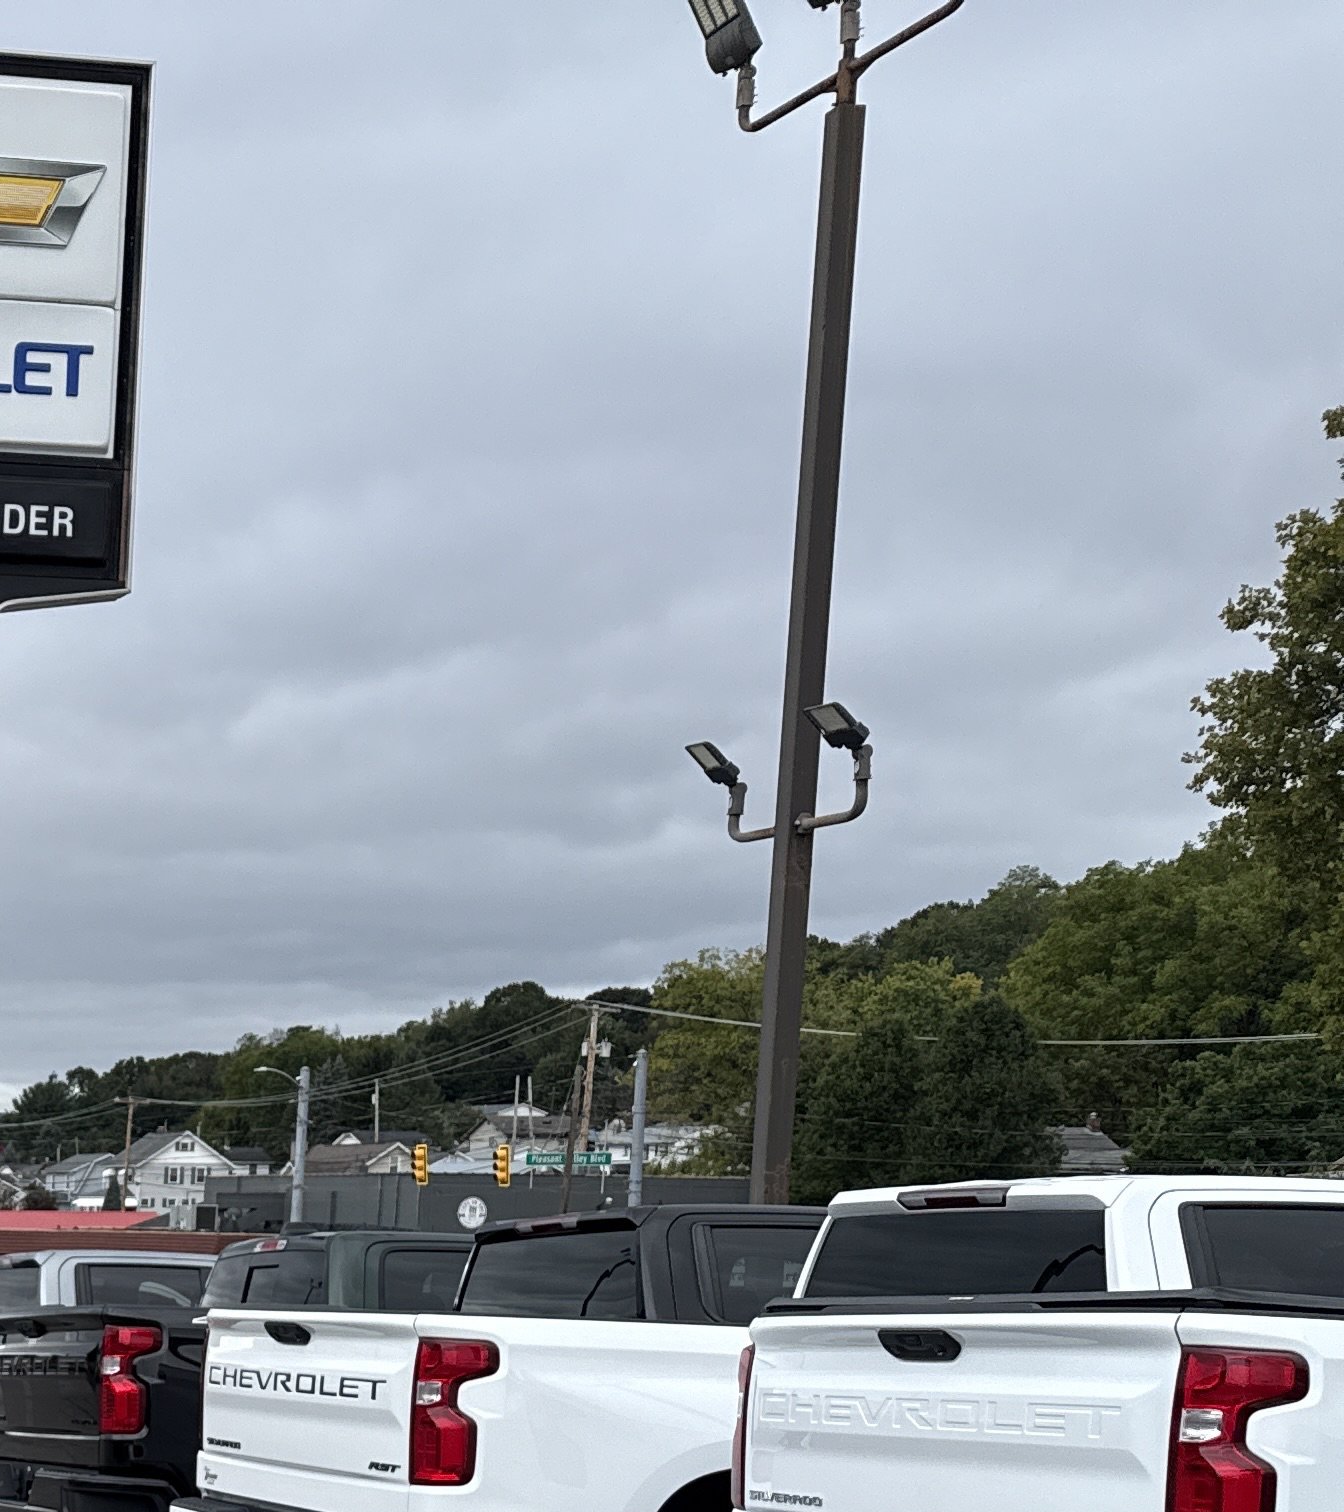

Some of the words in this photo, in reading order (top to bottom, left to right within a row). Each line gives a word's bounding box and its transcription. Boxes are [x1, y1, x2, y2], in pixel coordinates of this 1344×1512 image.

[531, 1154, 563, 1164] Pleasant
[590, 1154, 607, 1163] Blvd
[208, 1365, 388, 1401] CHEVROLET
[757, 1391, 1123, 1439] CHEVROLET
[368, 1461, 402, 1473] RST
[749, 1489, 824, 1507] SILVERADO
